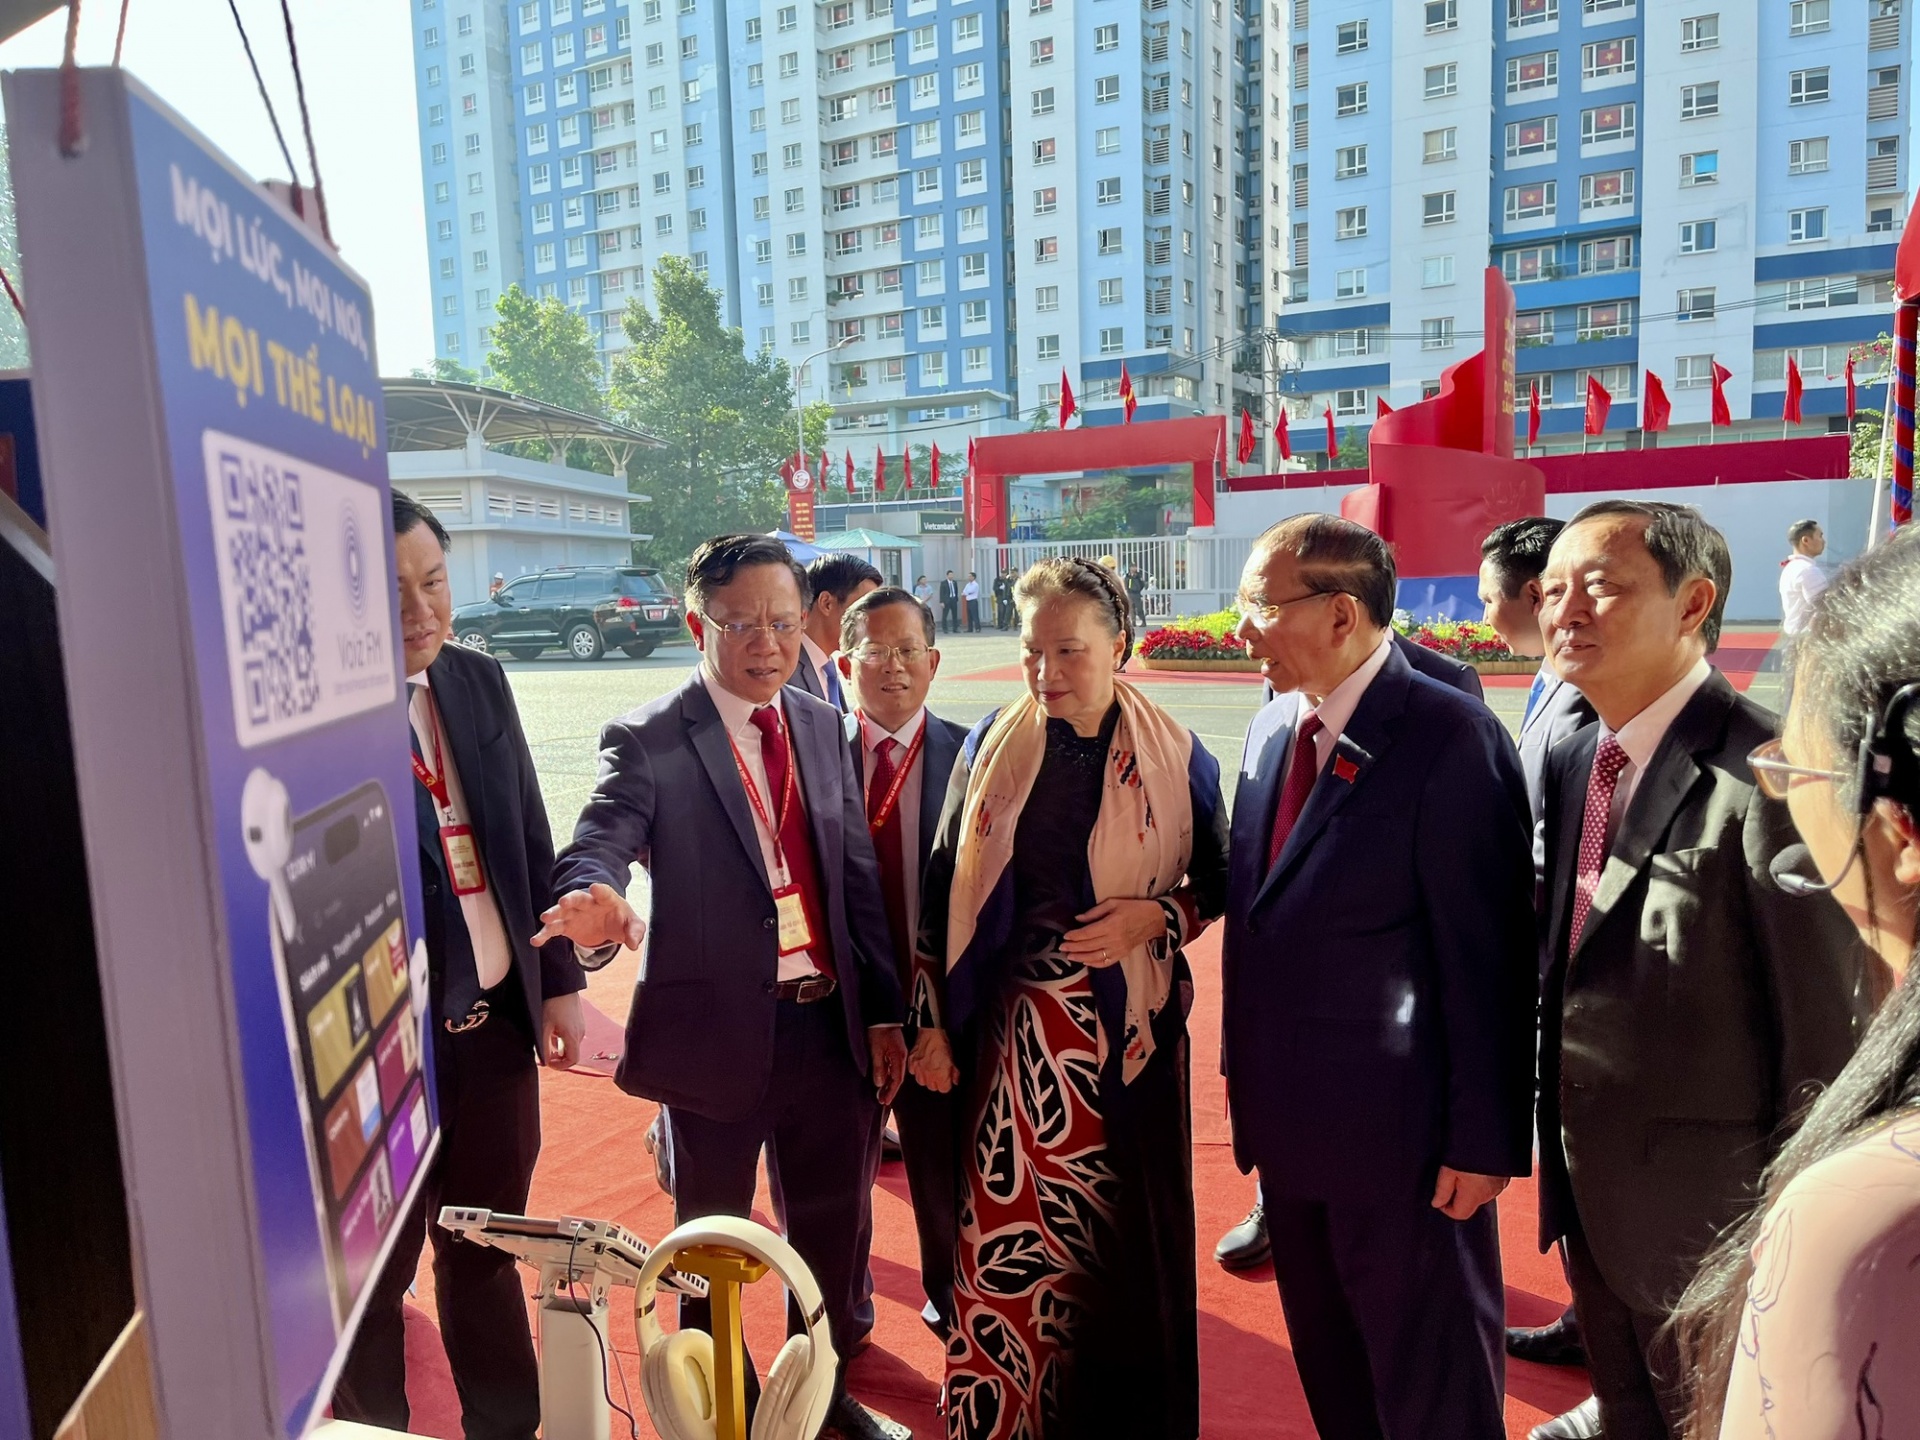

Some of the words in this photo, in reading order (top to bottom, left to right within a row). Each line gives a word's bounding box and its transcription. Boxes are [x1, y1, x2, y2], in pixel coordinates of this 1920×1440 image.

[170, 163, 234, 264] MỌI
[236, 214, 292, 309] LÚC,
[294, 259, 332, 335] MỌI
[333, 292, 368, 362] NƠI,
[184, 292, 265, 409] MỌI
[267, 340, 325, 425] THỂ
[327, 375, 377, 460] LOẠI
[923, 522, 956, 531] Vietcombank
